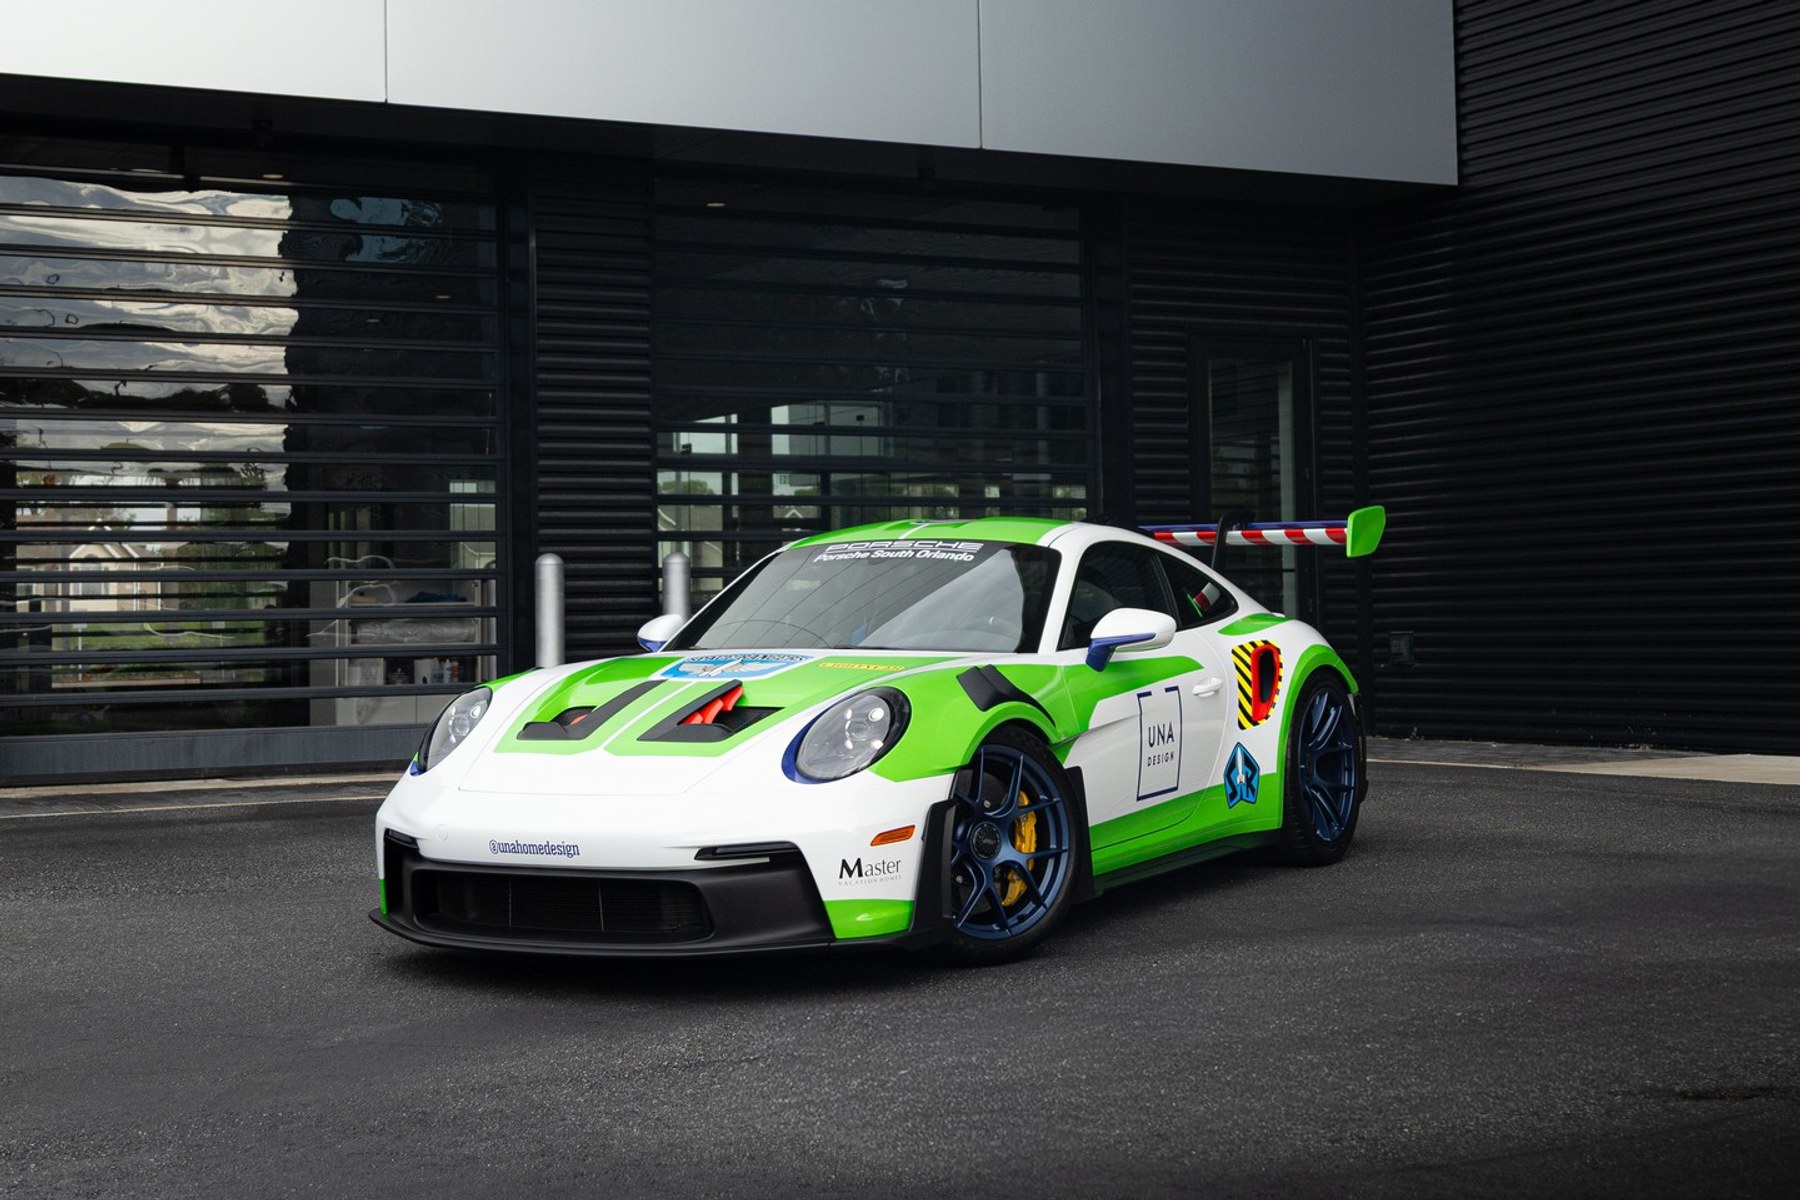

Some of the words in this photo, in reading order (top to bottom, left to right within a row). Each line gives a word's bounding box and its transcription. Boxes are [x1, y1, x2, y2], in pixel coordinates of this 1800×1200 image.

[825, 540, 984, 552] PORSCHE
[814, 551, 871, 562] Porsche
[871, 549, 915, 559] South
[916, 550, 975, 562] Orlando
[1148, 721, 1175, 748] UNA
[1147, 751, 1175, 767] DESIGN
[488, 839, 580, 858] @unahomedesign
[838, 857, 902, 879] Master
